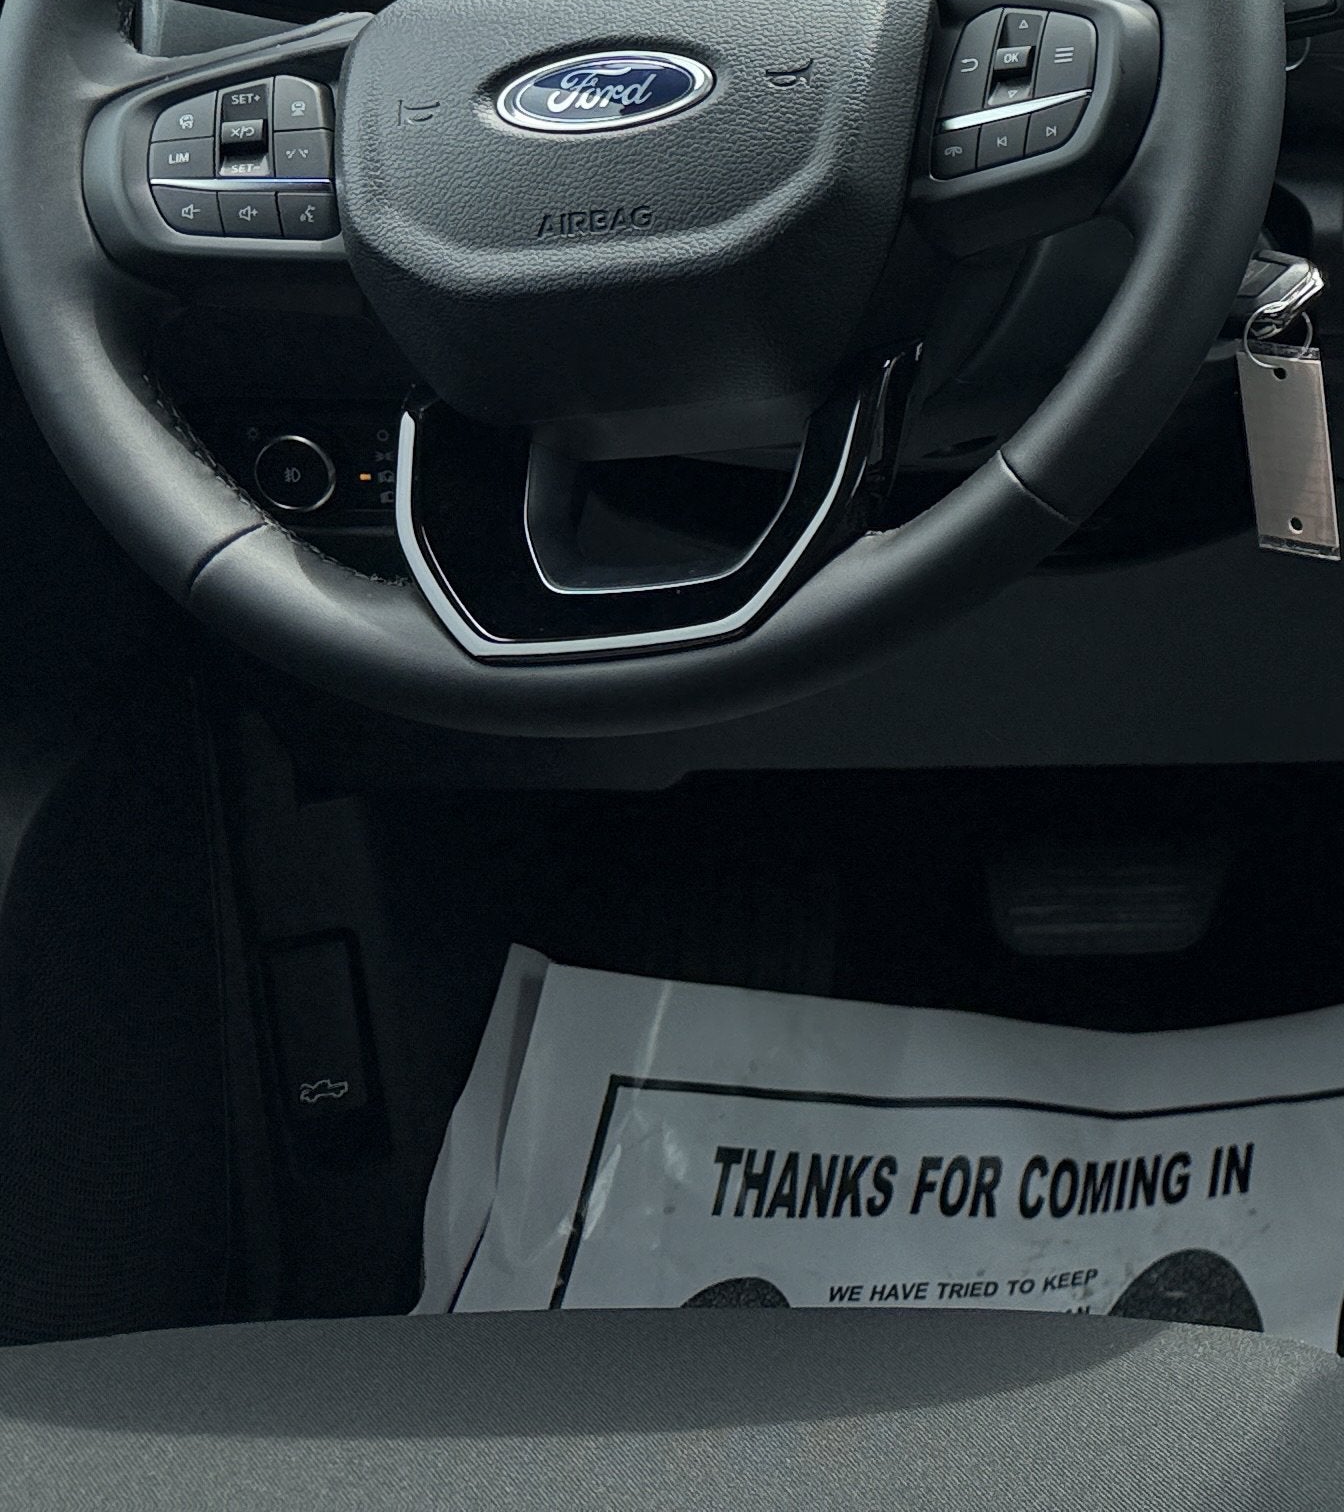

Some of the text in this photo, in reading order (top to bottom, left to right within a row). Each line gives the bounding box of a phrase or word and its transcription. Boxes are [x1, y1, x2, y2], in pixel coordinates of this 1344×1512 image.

[1003, 52, 1019, 64] OK
[547, 66, 657, 113] Ford
[168, 152, 189, 164] LIM
[538, 205, 653, 238] AIRBAG
[711, 1143, 1254, 1220] THANKS FOR COMING IN
[828, 1268, 1098, 1303] WE HAVE TRIED TO KEEP
